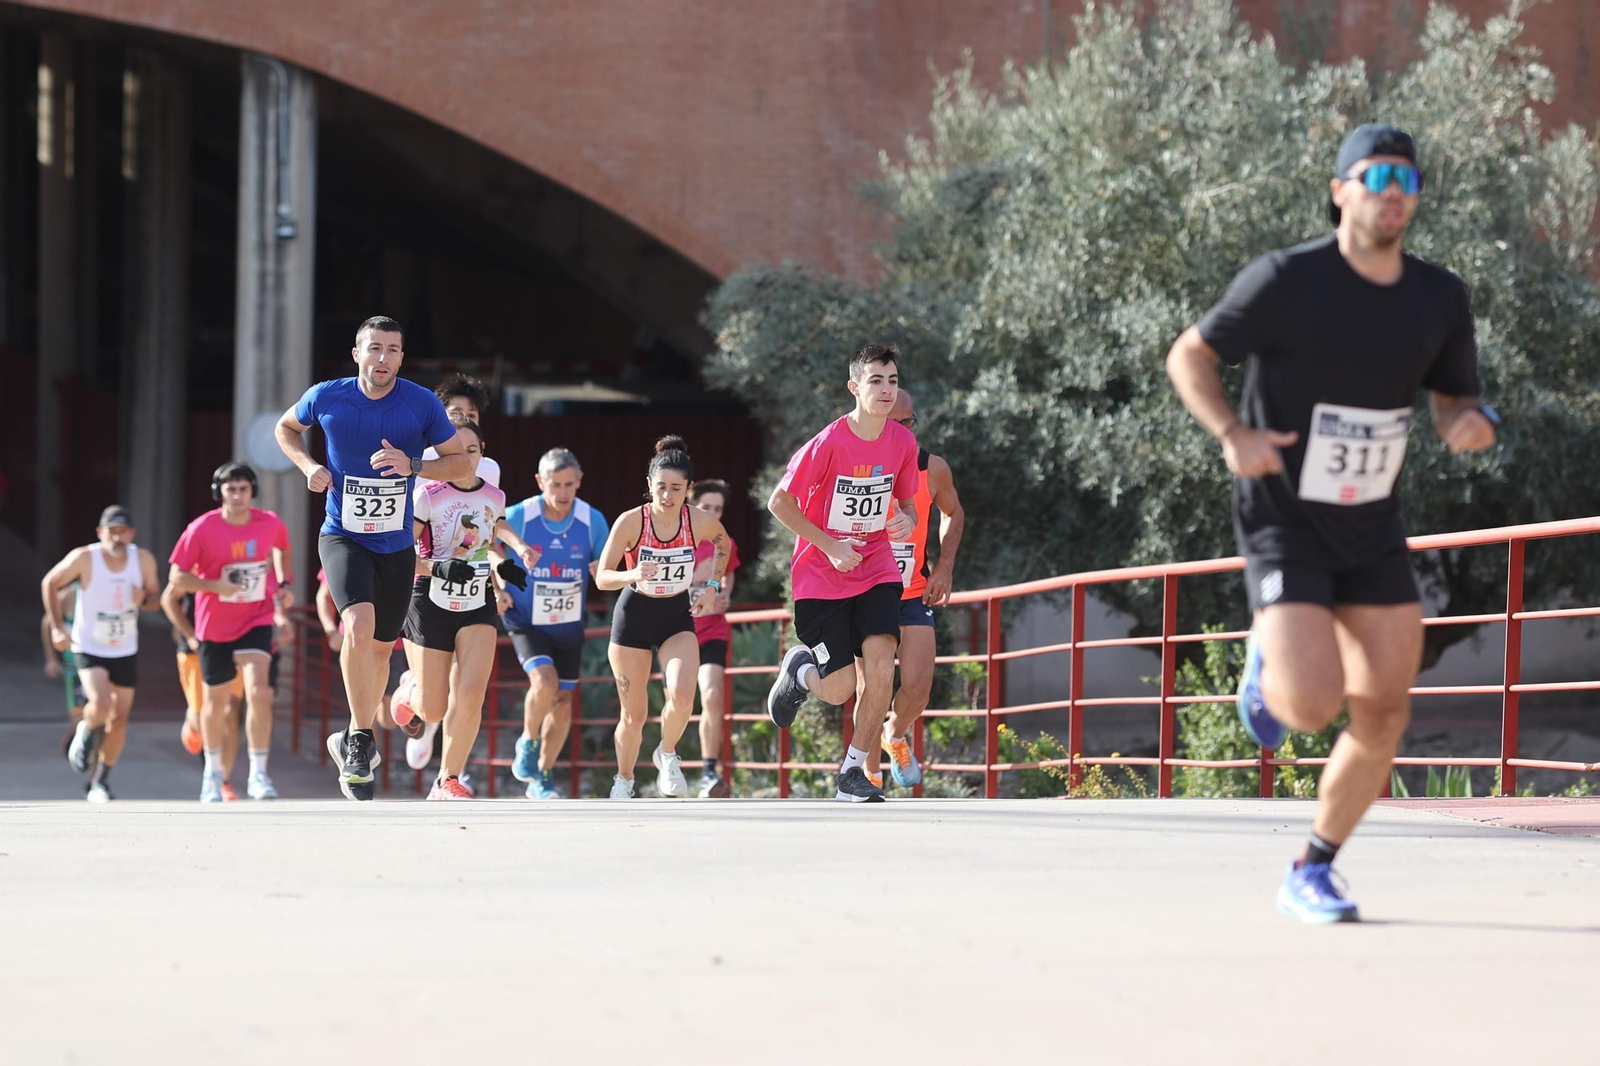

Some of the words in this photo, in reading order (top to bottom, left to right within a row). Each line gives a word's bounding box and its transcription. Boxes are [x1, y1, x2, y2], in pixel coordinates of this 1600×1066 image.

[1325, 443, 1389, 475] 311
[347, 485, 375, 495] UMA
[838, 485, 867, 494] UMA
[353, 498, 397, 517] 323
[842, 495, 882, 517] 301
[231, 540, 257, 558] WE
[640, 554, 667, 564] UMA
[646, 565, 686, 581] 14
[441, 579, 480, 597] 416
[542, 596, 575, 613] 546
